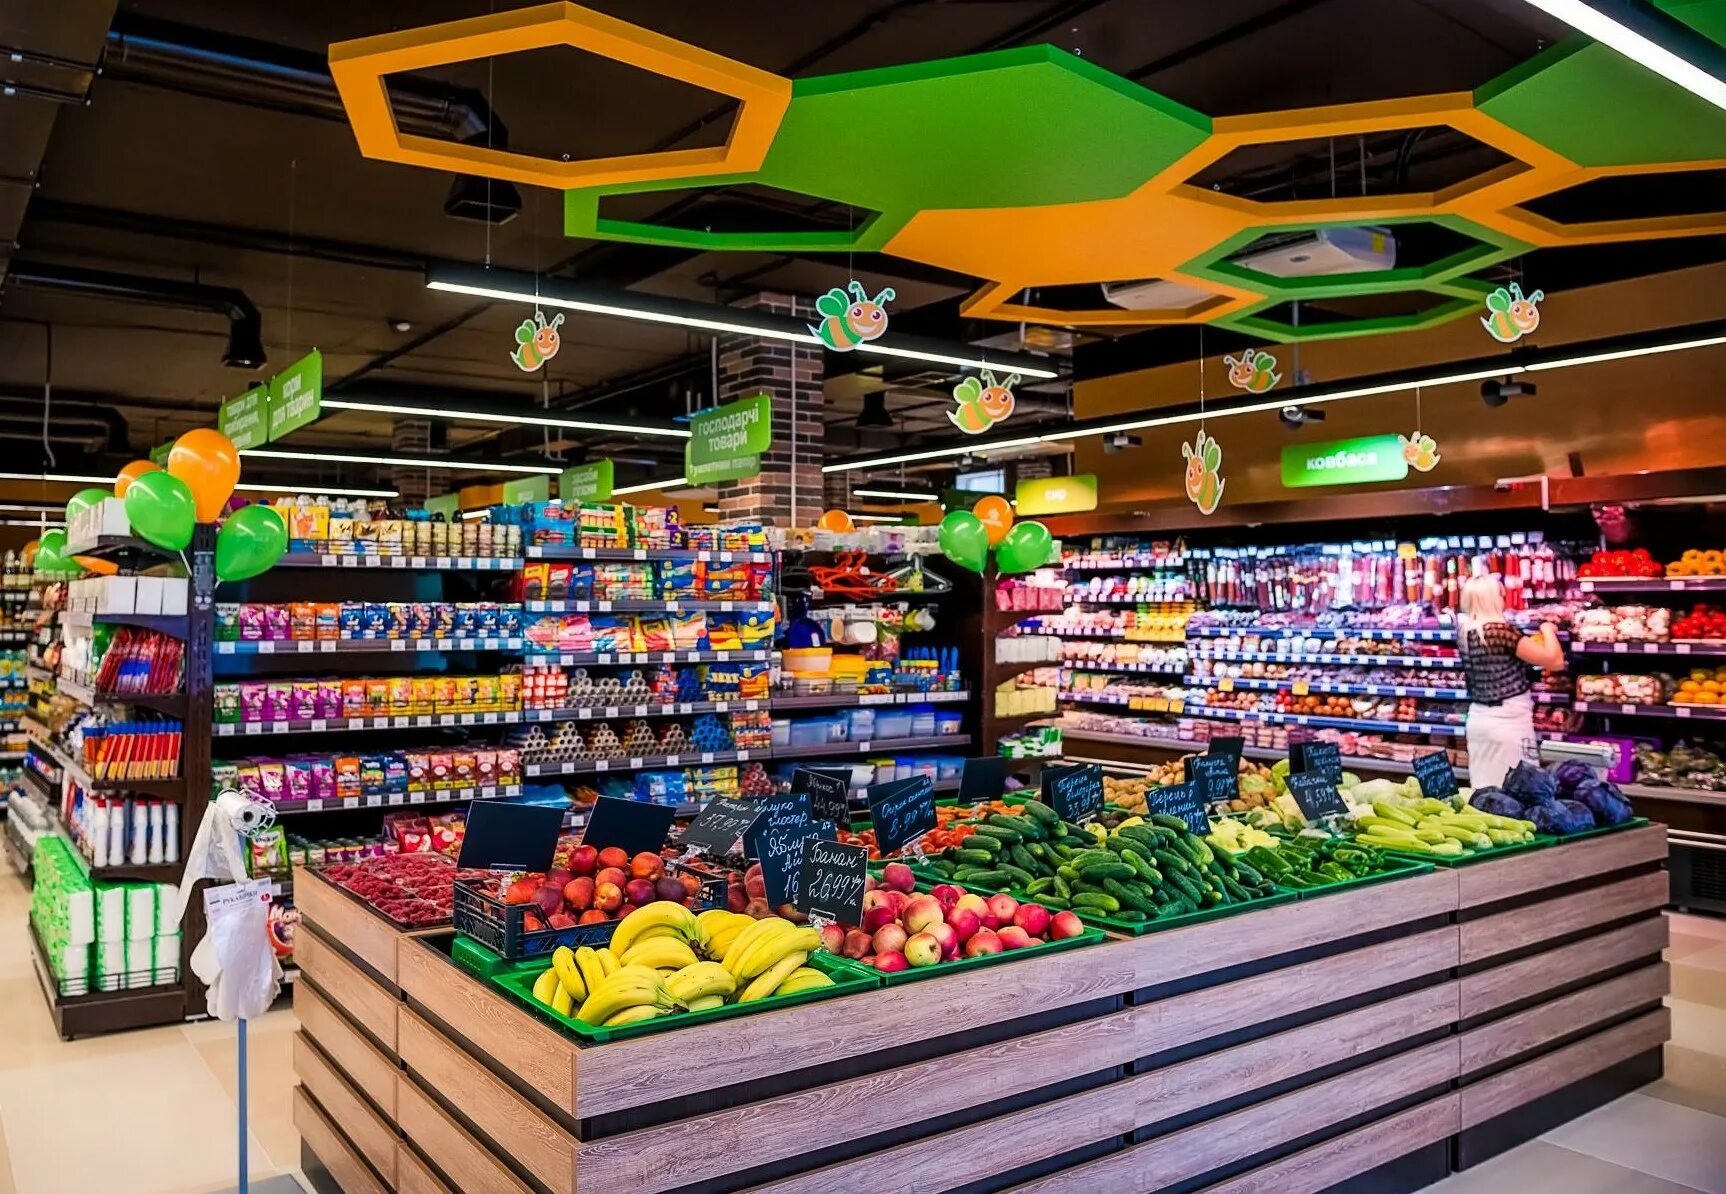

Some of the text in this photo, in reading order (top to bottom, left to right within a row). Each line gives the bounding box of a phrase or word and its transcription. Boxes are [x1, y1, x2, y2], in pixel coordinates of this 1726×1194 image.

[698, 402, 759, 436] господарчі
[708, 431, 748, 452] товари
[1306, 450, 1378, 471] ковбаса
[810, 841, 858, 868] Банан
